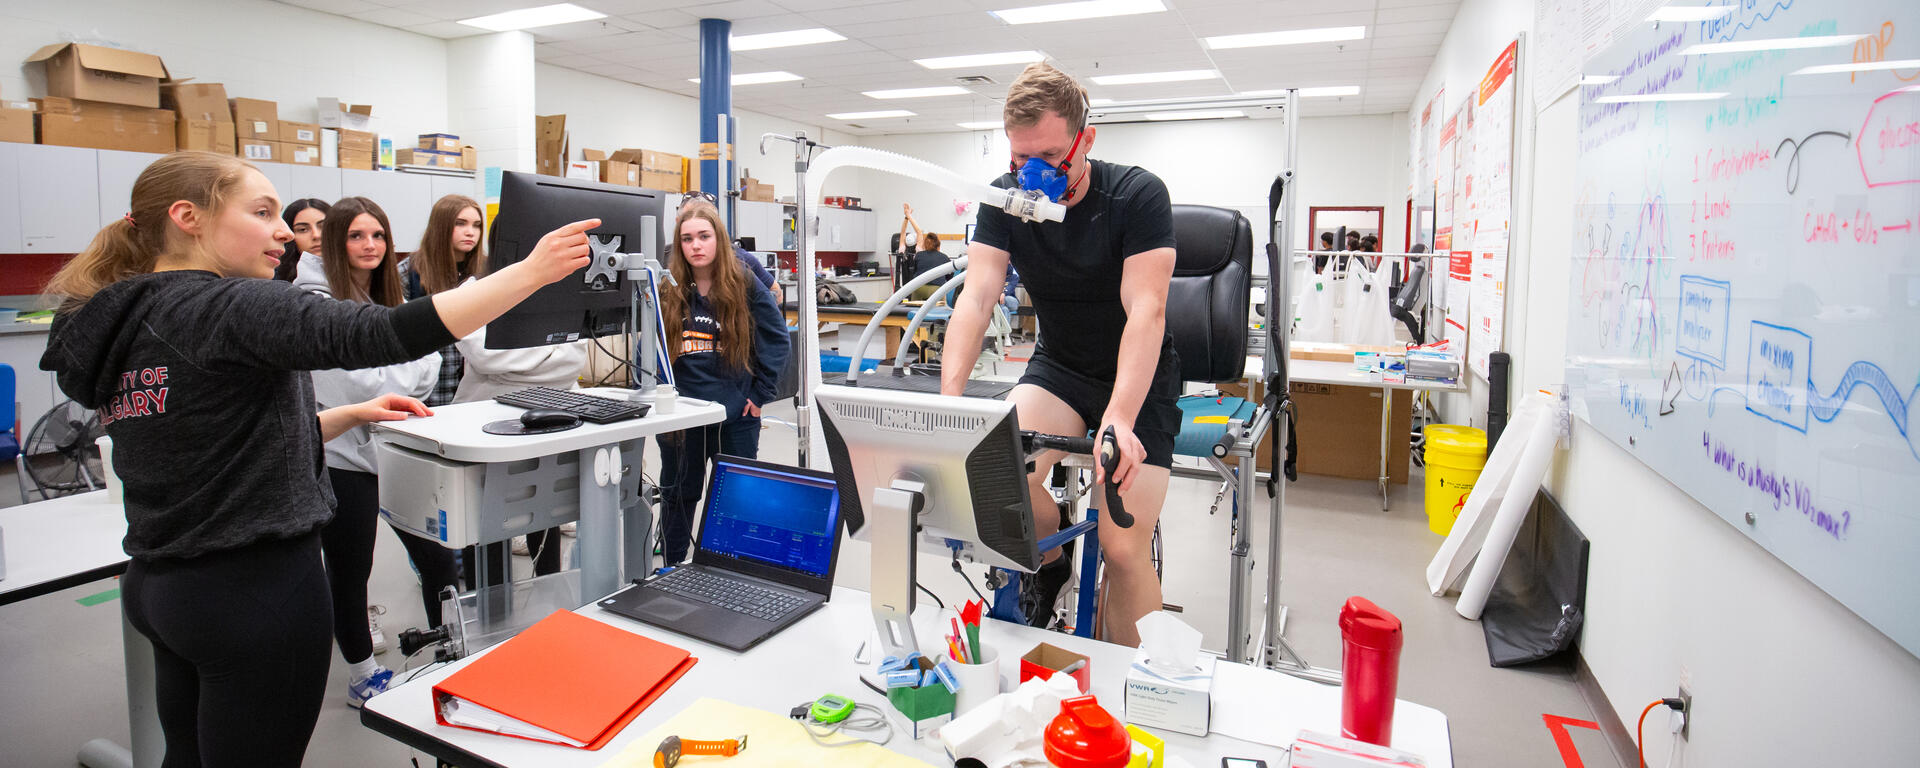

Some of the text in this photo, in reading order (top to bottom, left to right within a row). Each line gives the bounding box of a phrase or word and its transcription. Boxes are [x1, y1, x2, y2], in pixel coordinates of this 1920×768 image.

[141, 366, 168, 386] OF
[1714, 439, 1735, 472] What
[1737, 461, 1746, 481] is
[1748, 466, 1754, 487] a
[1129, 682, 1150, 692] VWR
